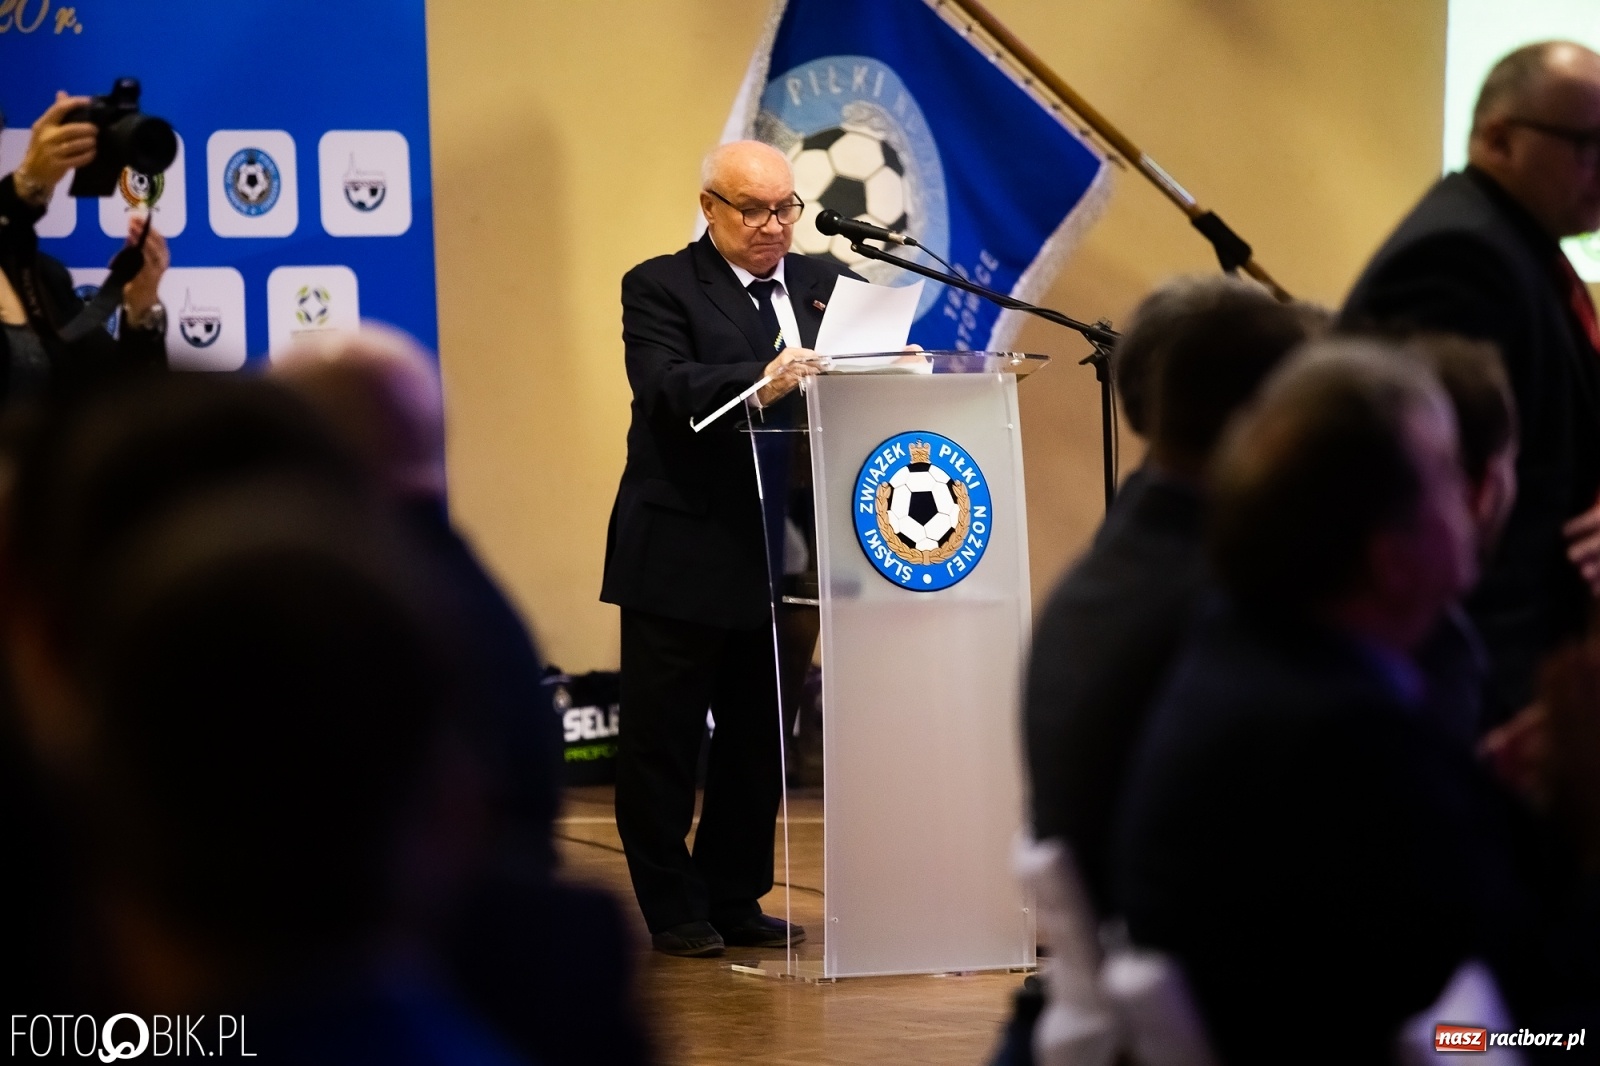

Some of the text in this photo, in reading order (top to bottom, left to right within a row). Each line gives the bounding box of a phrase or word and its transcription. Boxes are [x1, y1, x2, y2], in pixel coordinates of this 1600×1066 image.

[859, 442, 987, 583] ŚLĄSKI ZWIĄZEK PIŁKI NOŻNEJ
[562, 704, 619, 742] SELE
